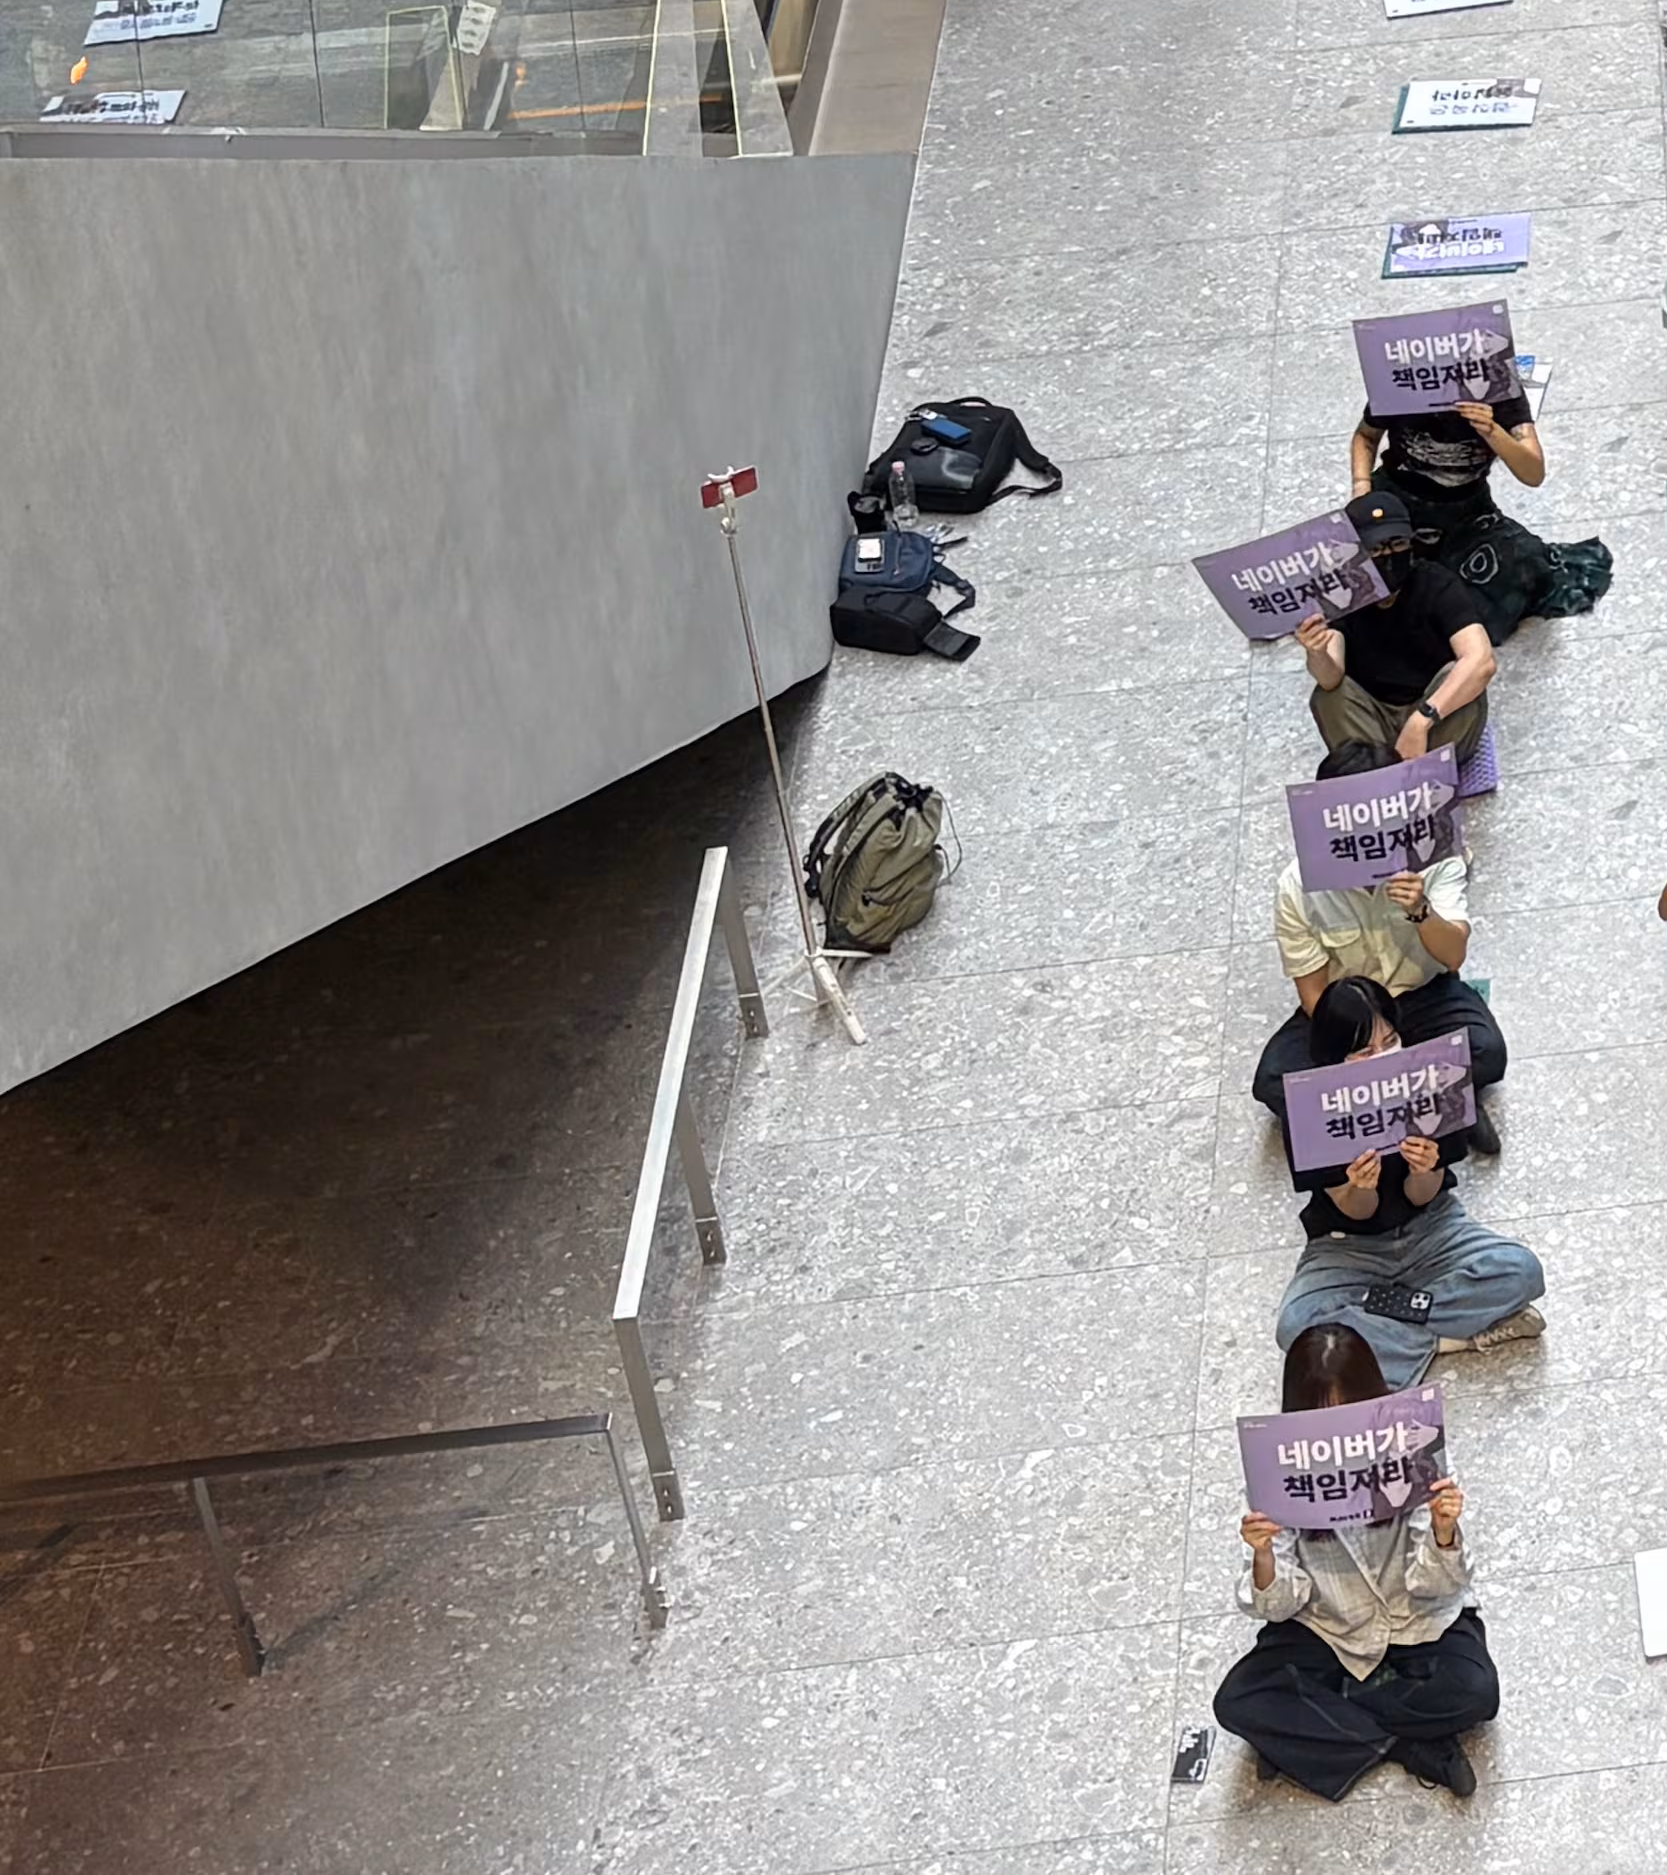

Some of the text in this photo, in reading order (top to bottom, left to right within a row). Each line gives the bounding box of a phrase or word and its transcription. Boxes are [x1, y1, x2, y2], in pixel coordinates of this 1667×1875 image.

[1385, 329, 1486, 363] 네이버가
[1391, 357, 1489, 390] 책임져라
[1231, 543, 1334, 593] 네이버가
[1248, 570, 1348, 615] 책임져라
[1322, 784, 1434, 831] 네이버가
[1330, 817, 1435, 860] 책임져라
[1321, 1066, 1440, 1114] 네이버가
[1326, 1094, 1440, 1139] 책임져라
[1277, 1425, 1408, 1470] 네이버가
[1283, 1459, 1412, 1501] 책임져라
